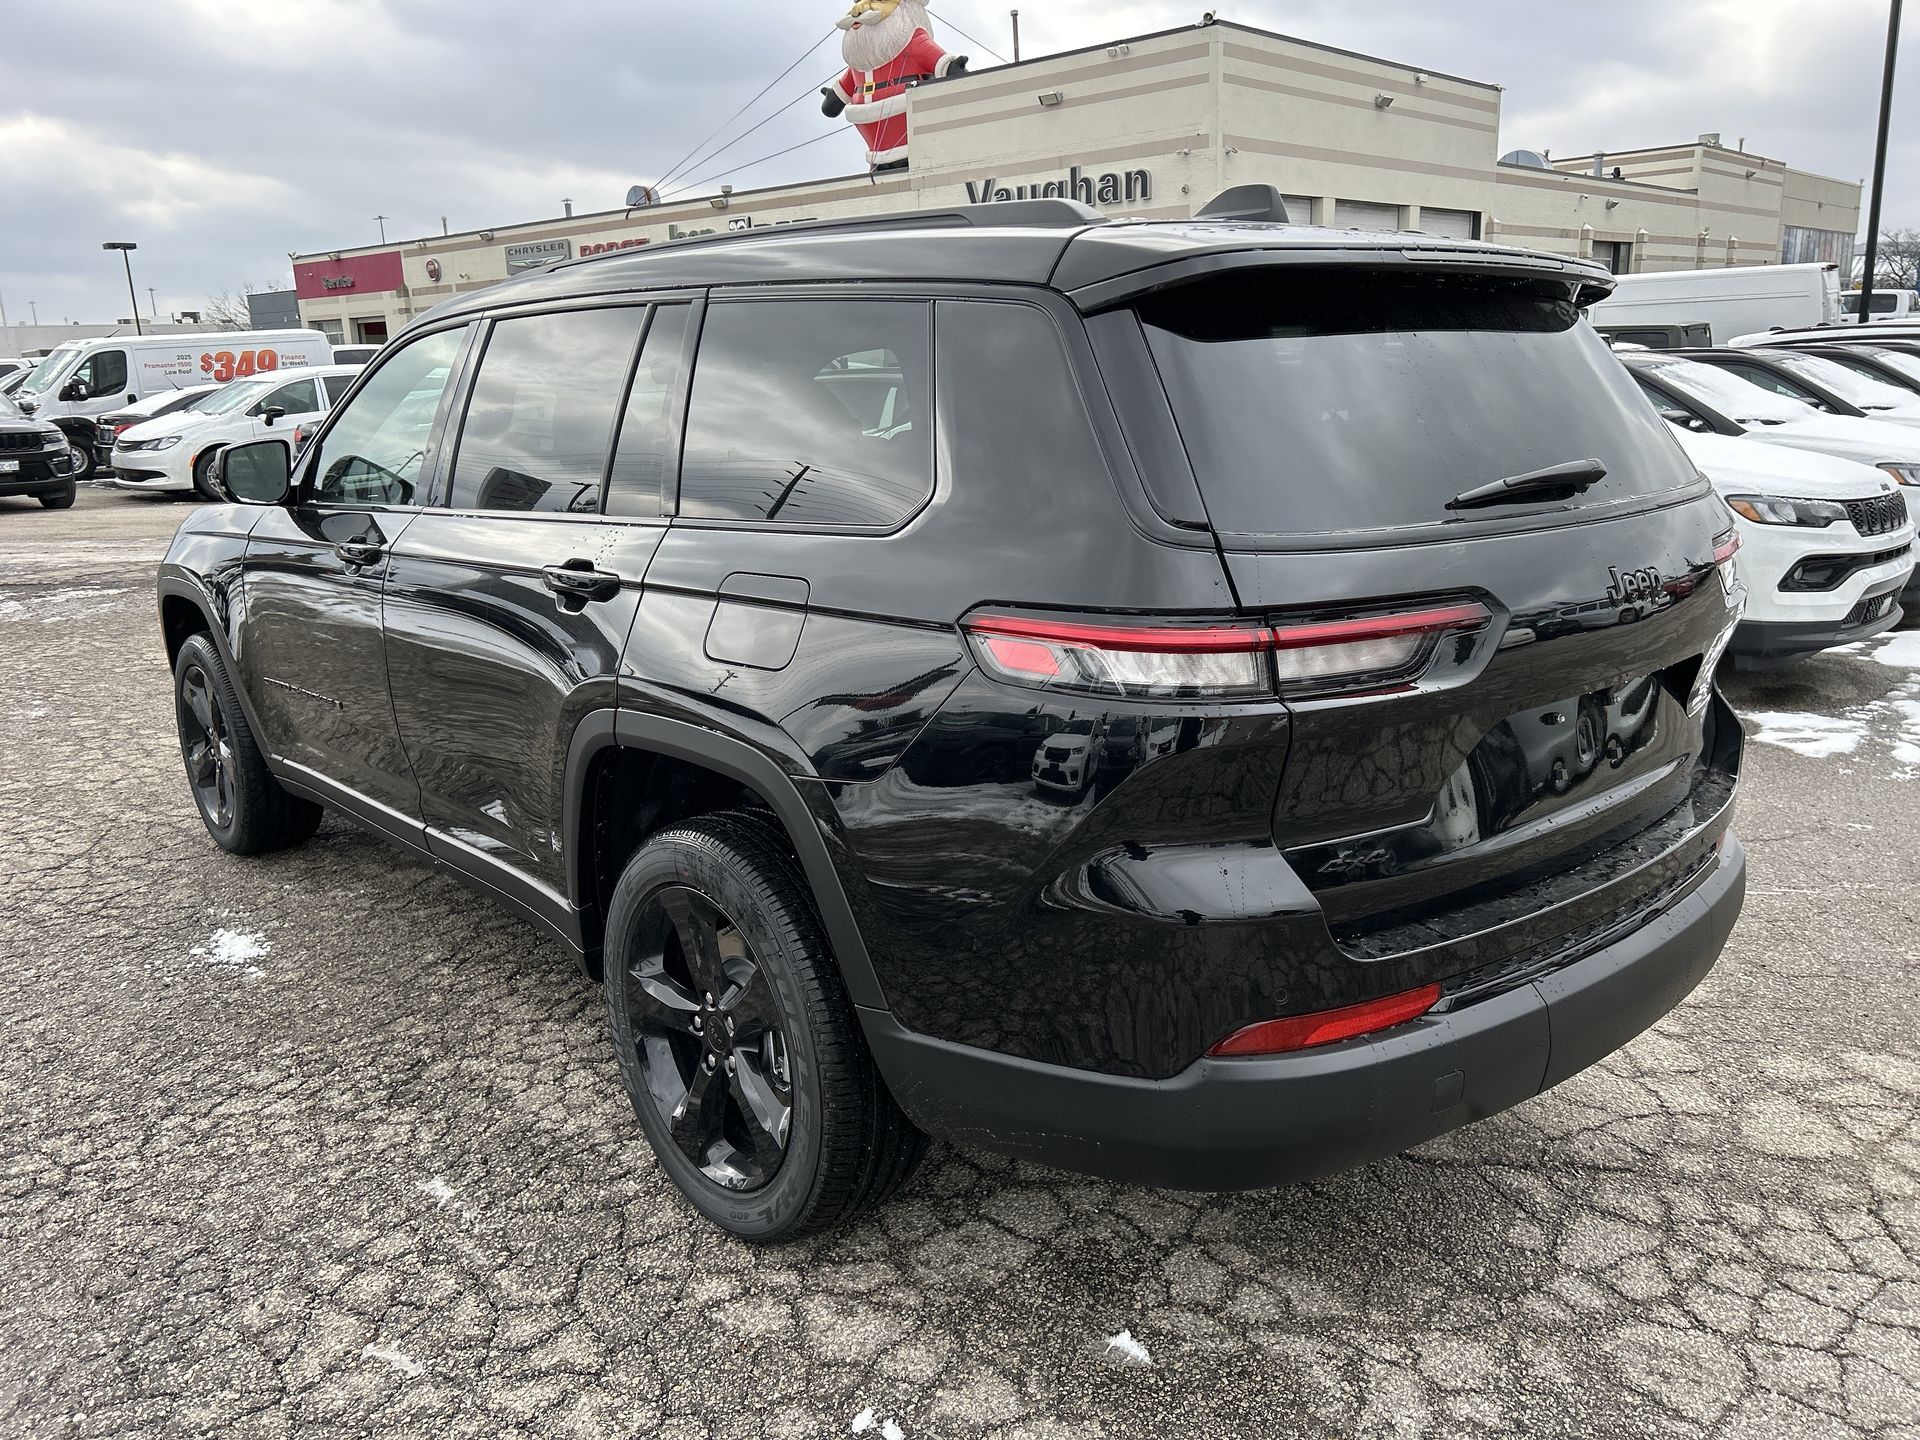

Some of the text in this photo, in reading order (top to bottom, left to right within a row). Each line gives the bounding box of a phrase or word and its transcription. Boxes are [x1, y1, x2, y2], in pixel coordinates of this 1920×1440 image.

[507, 242, 565, 256] CHRYSLER
[321, 275, 354, 290] Service
[280, 353, 306, 361] Finance
[200, 348, 279, 383] $349
[1606, 565, 1664, 609] Jeep
